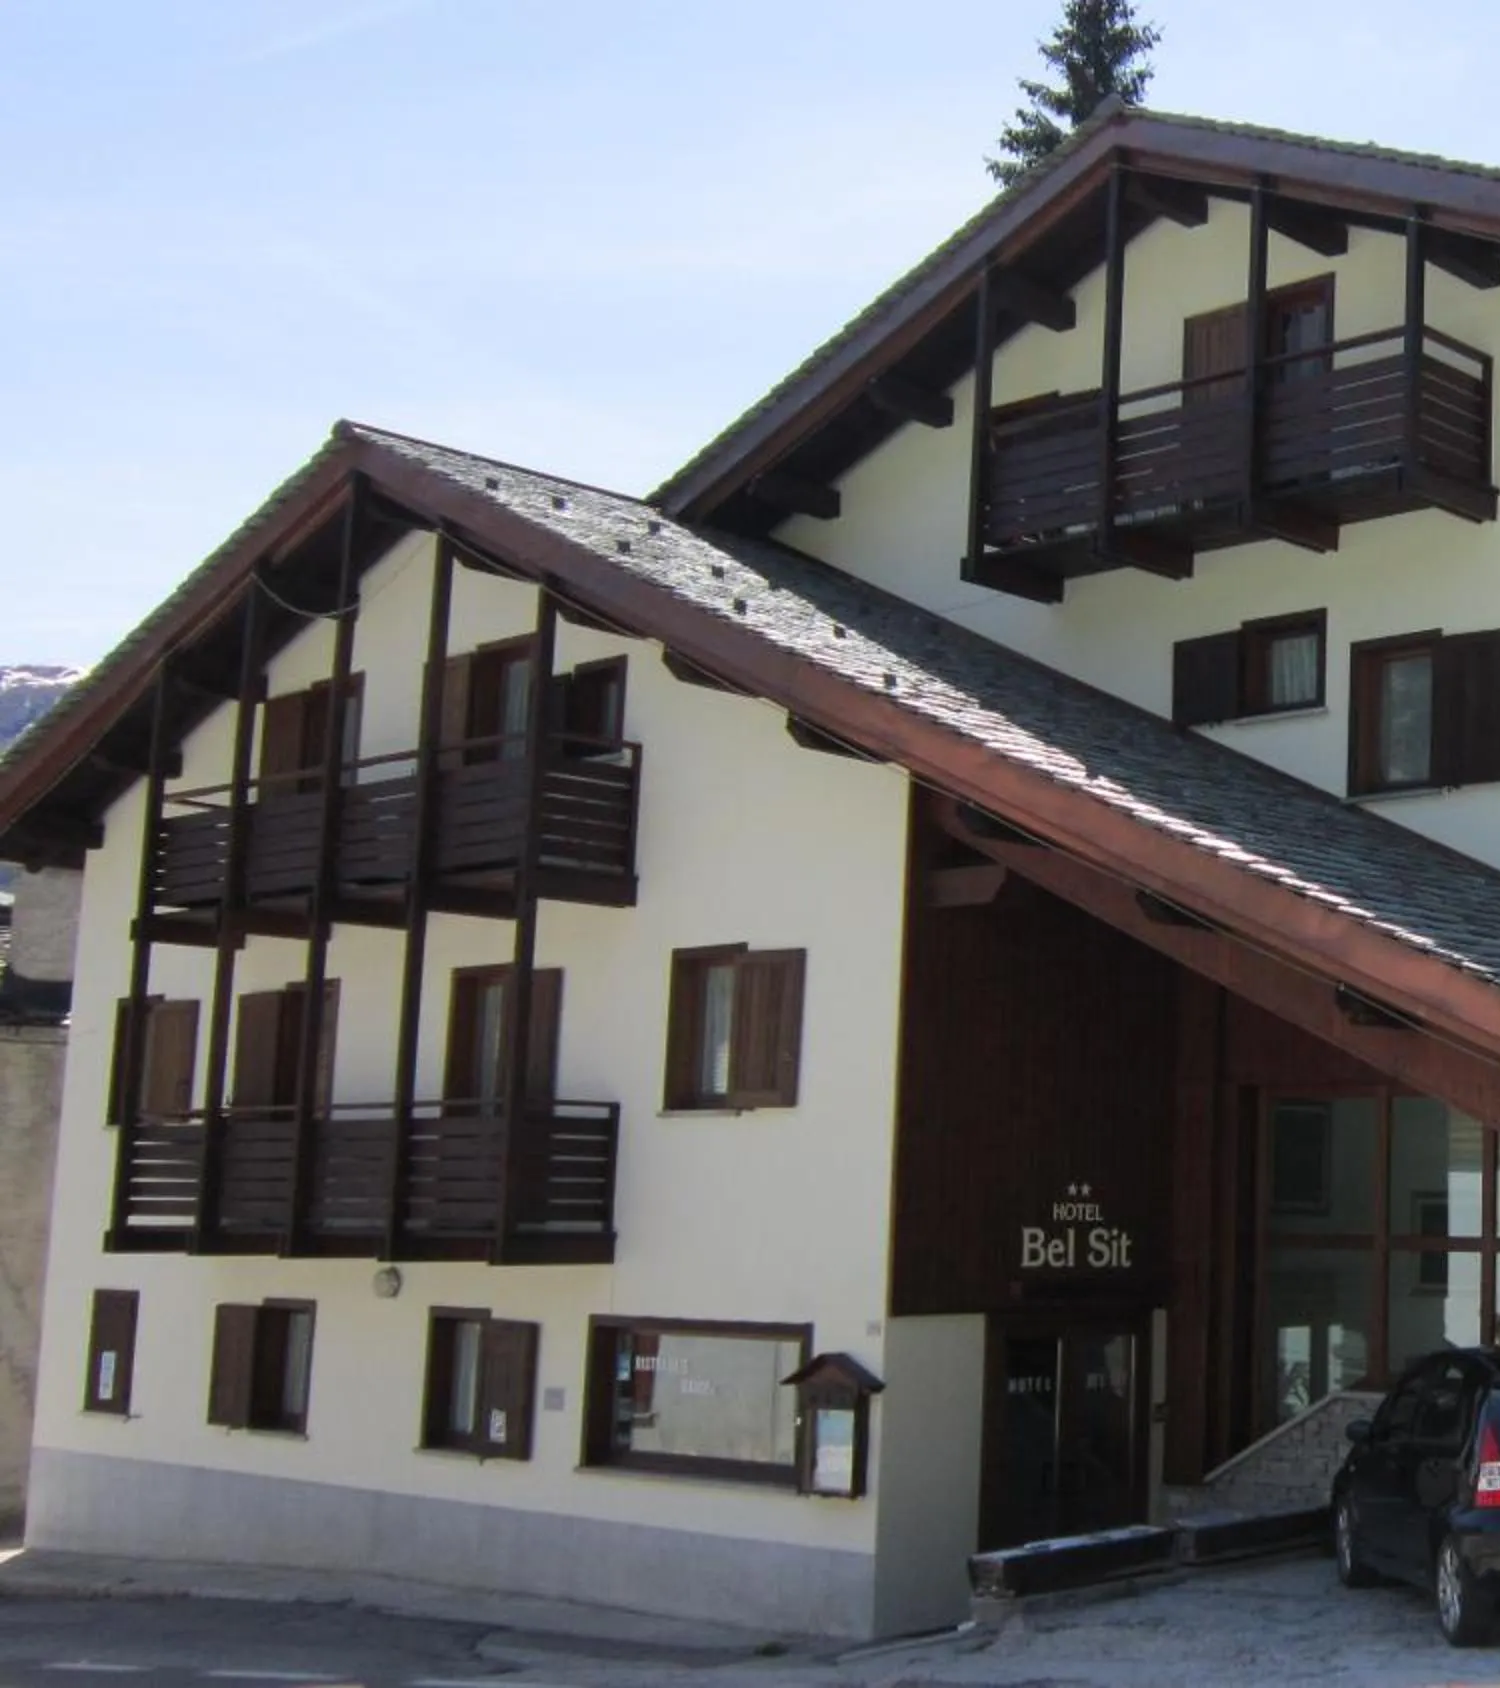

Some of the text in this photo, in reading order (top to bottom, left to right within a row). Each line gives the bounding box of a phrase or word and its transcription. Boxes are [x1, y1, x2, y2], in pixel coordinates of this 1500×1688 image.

[1053, 1203, 1103, 1221] HOTEL
[1021, 1226, 1132, 1267] Bel Sit
